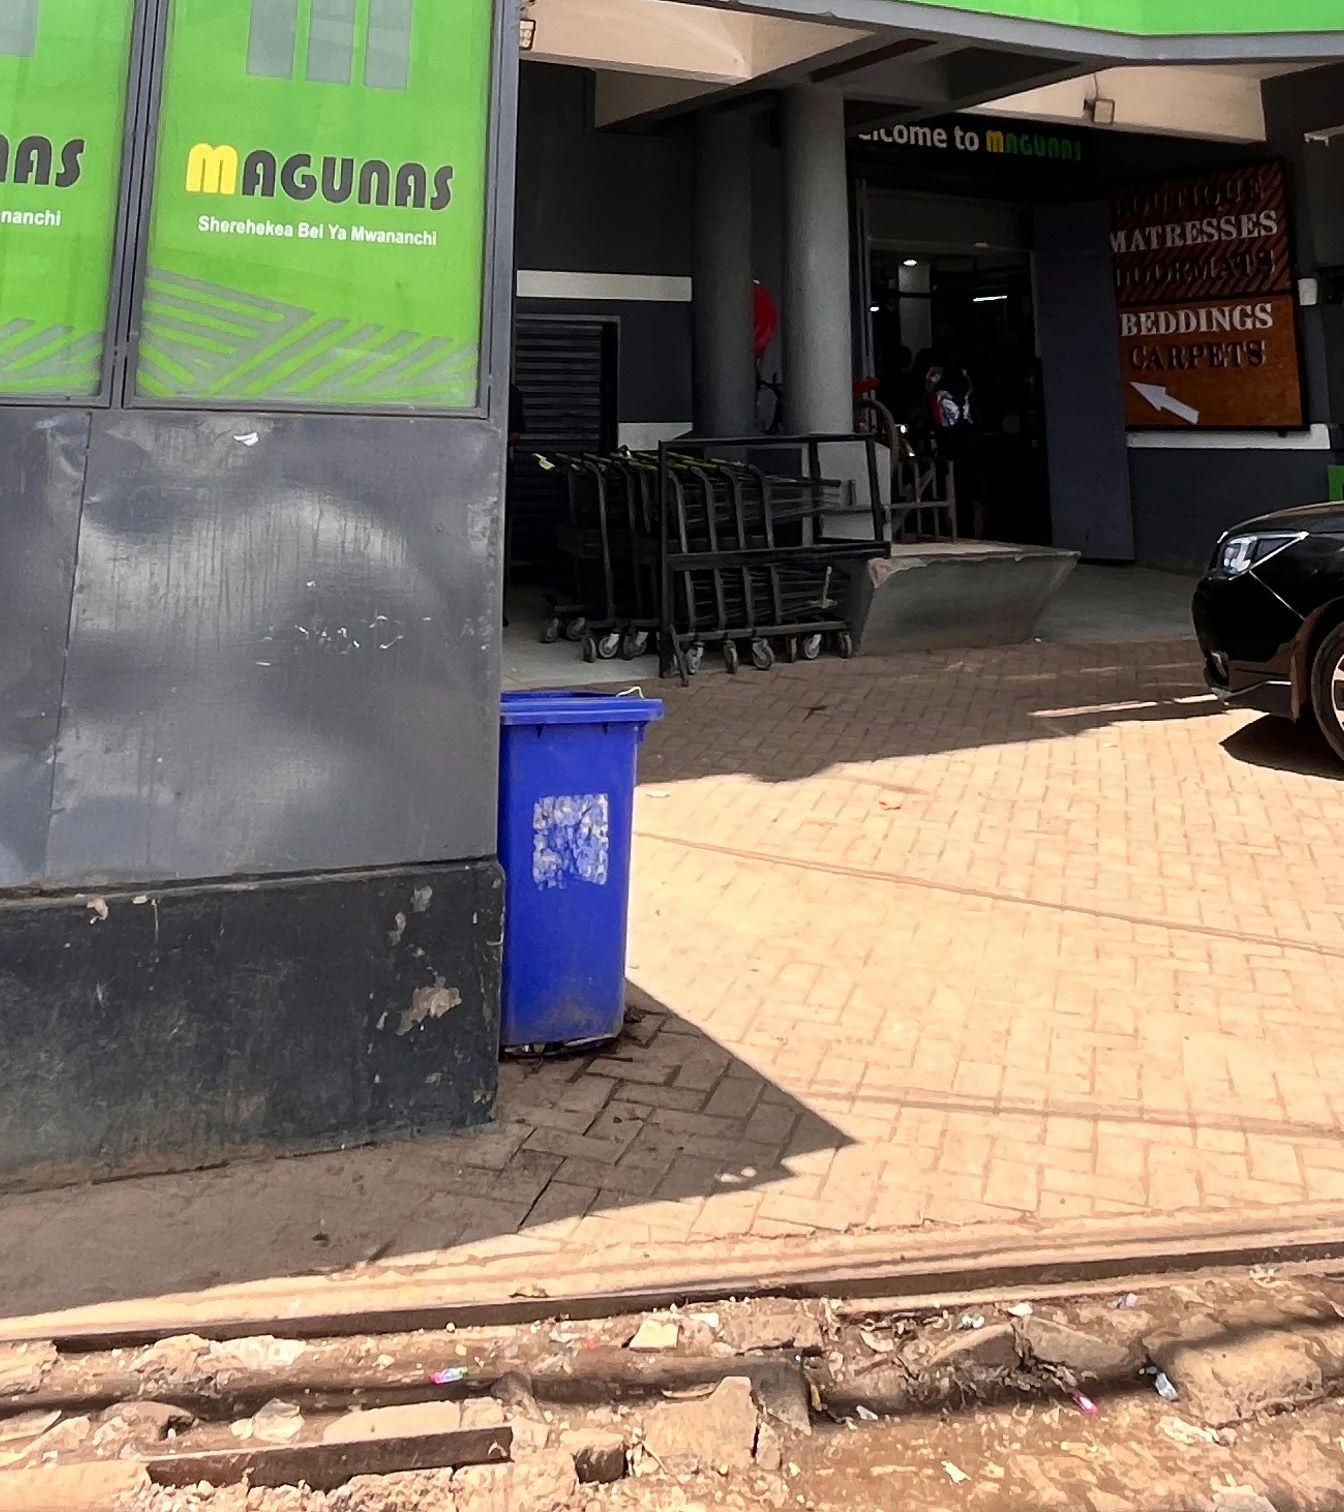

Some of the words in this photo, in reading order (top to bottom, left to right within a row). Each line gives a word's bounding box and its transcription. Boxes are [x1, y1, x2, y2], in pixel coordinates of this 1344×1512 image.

[954, 125, 980, 151] to
[197, 215, 294, 237] Sherehekea
[298, 222, 324, 239] Bei
[328, 223, 347, 241] Ya
[350, 225, 437, 246] Mwananchi
[1109, 209, 1278, 253] MATRESSES
[1119, 302, 1274, 337] BEDDINGS
[1128, 339, 1266, 371] CARPETS
